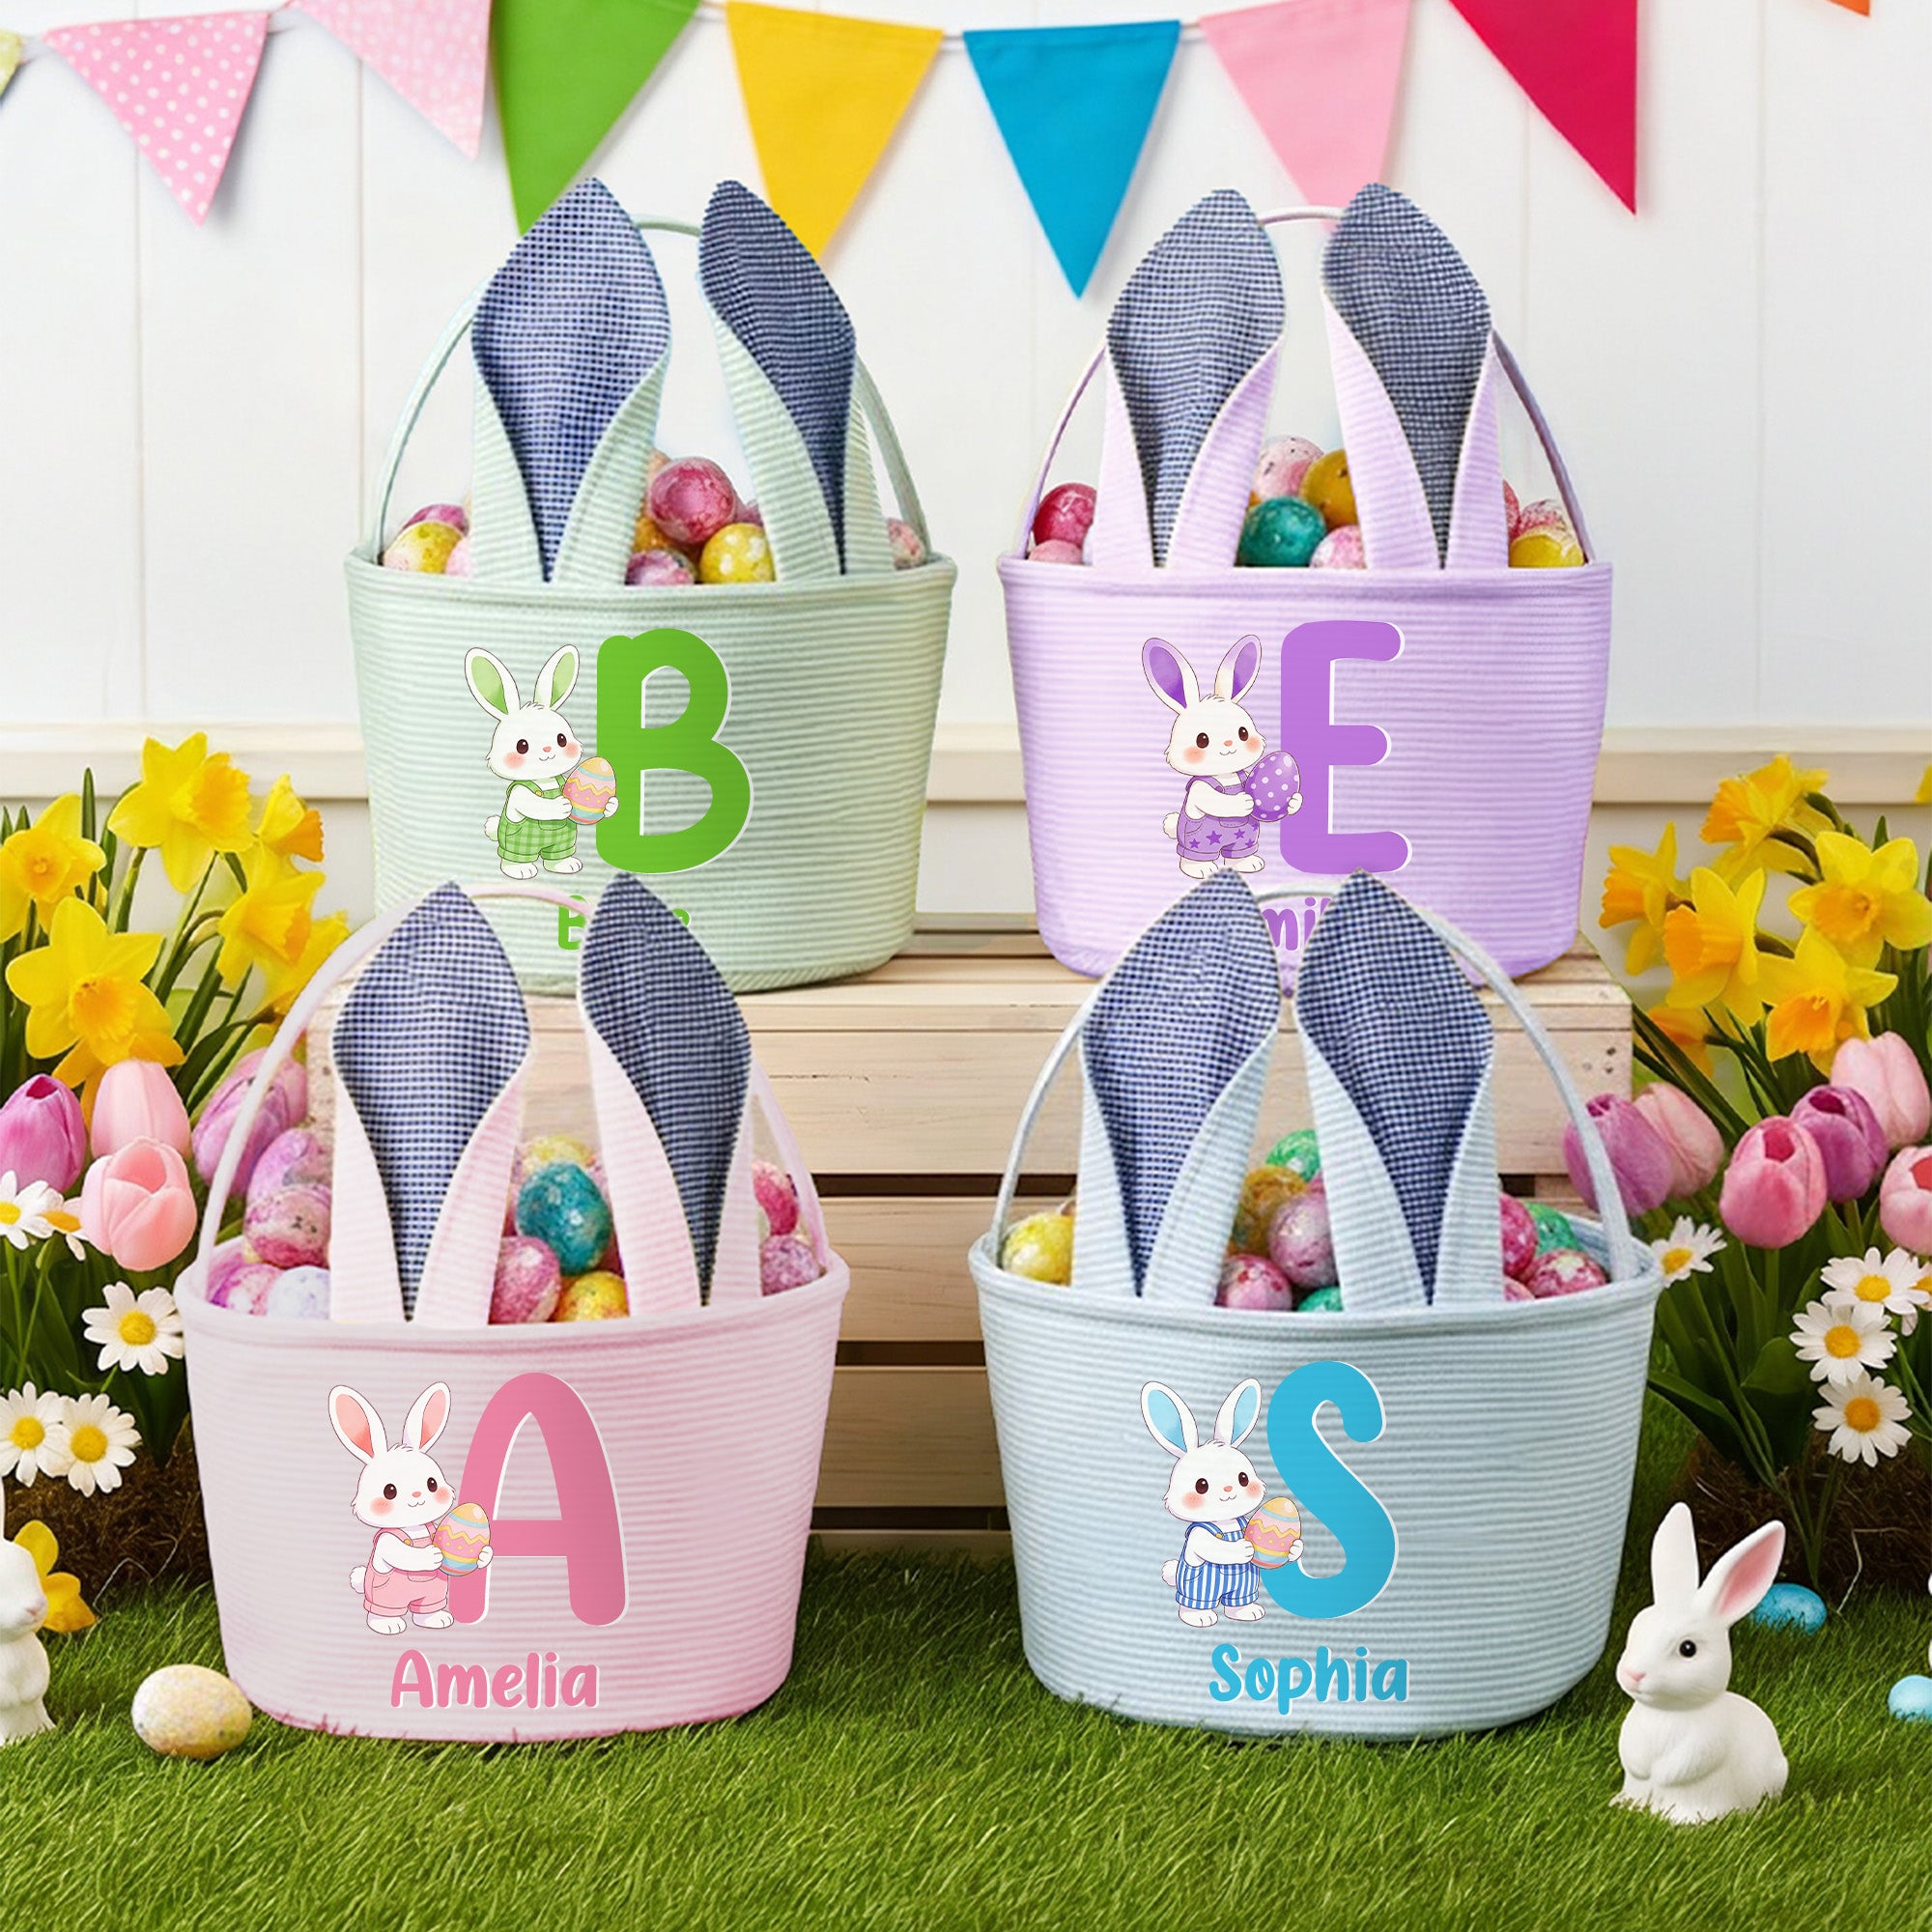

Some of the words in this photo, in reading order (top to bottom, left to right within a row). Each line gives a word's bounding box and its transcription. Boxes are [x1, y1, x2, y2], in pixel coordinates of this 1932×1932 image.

[596, 628, 754, 874] B
[1280, 620, 1412, 874] E
[448, 1372, 630, 1626] A
[1260, 1360, 1400, 1620] S
[390, 1649, 600, 1709] Amelia
[1208, 1642, 1409, 1716] Sophia
